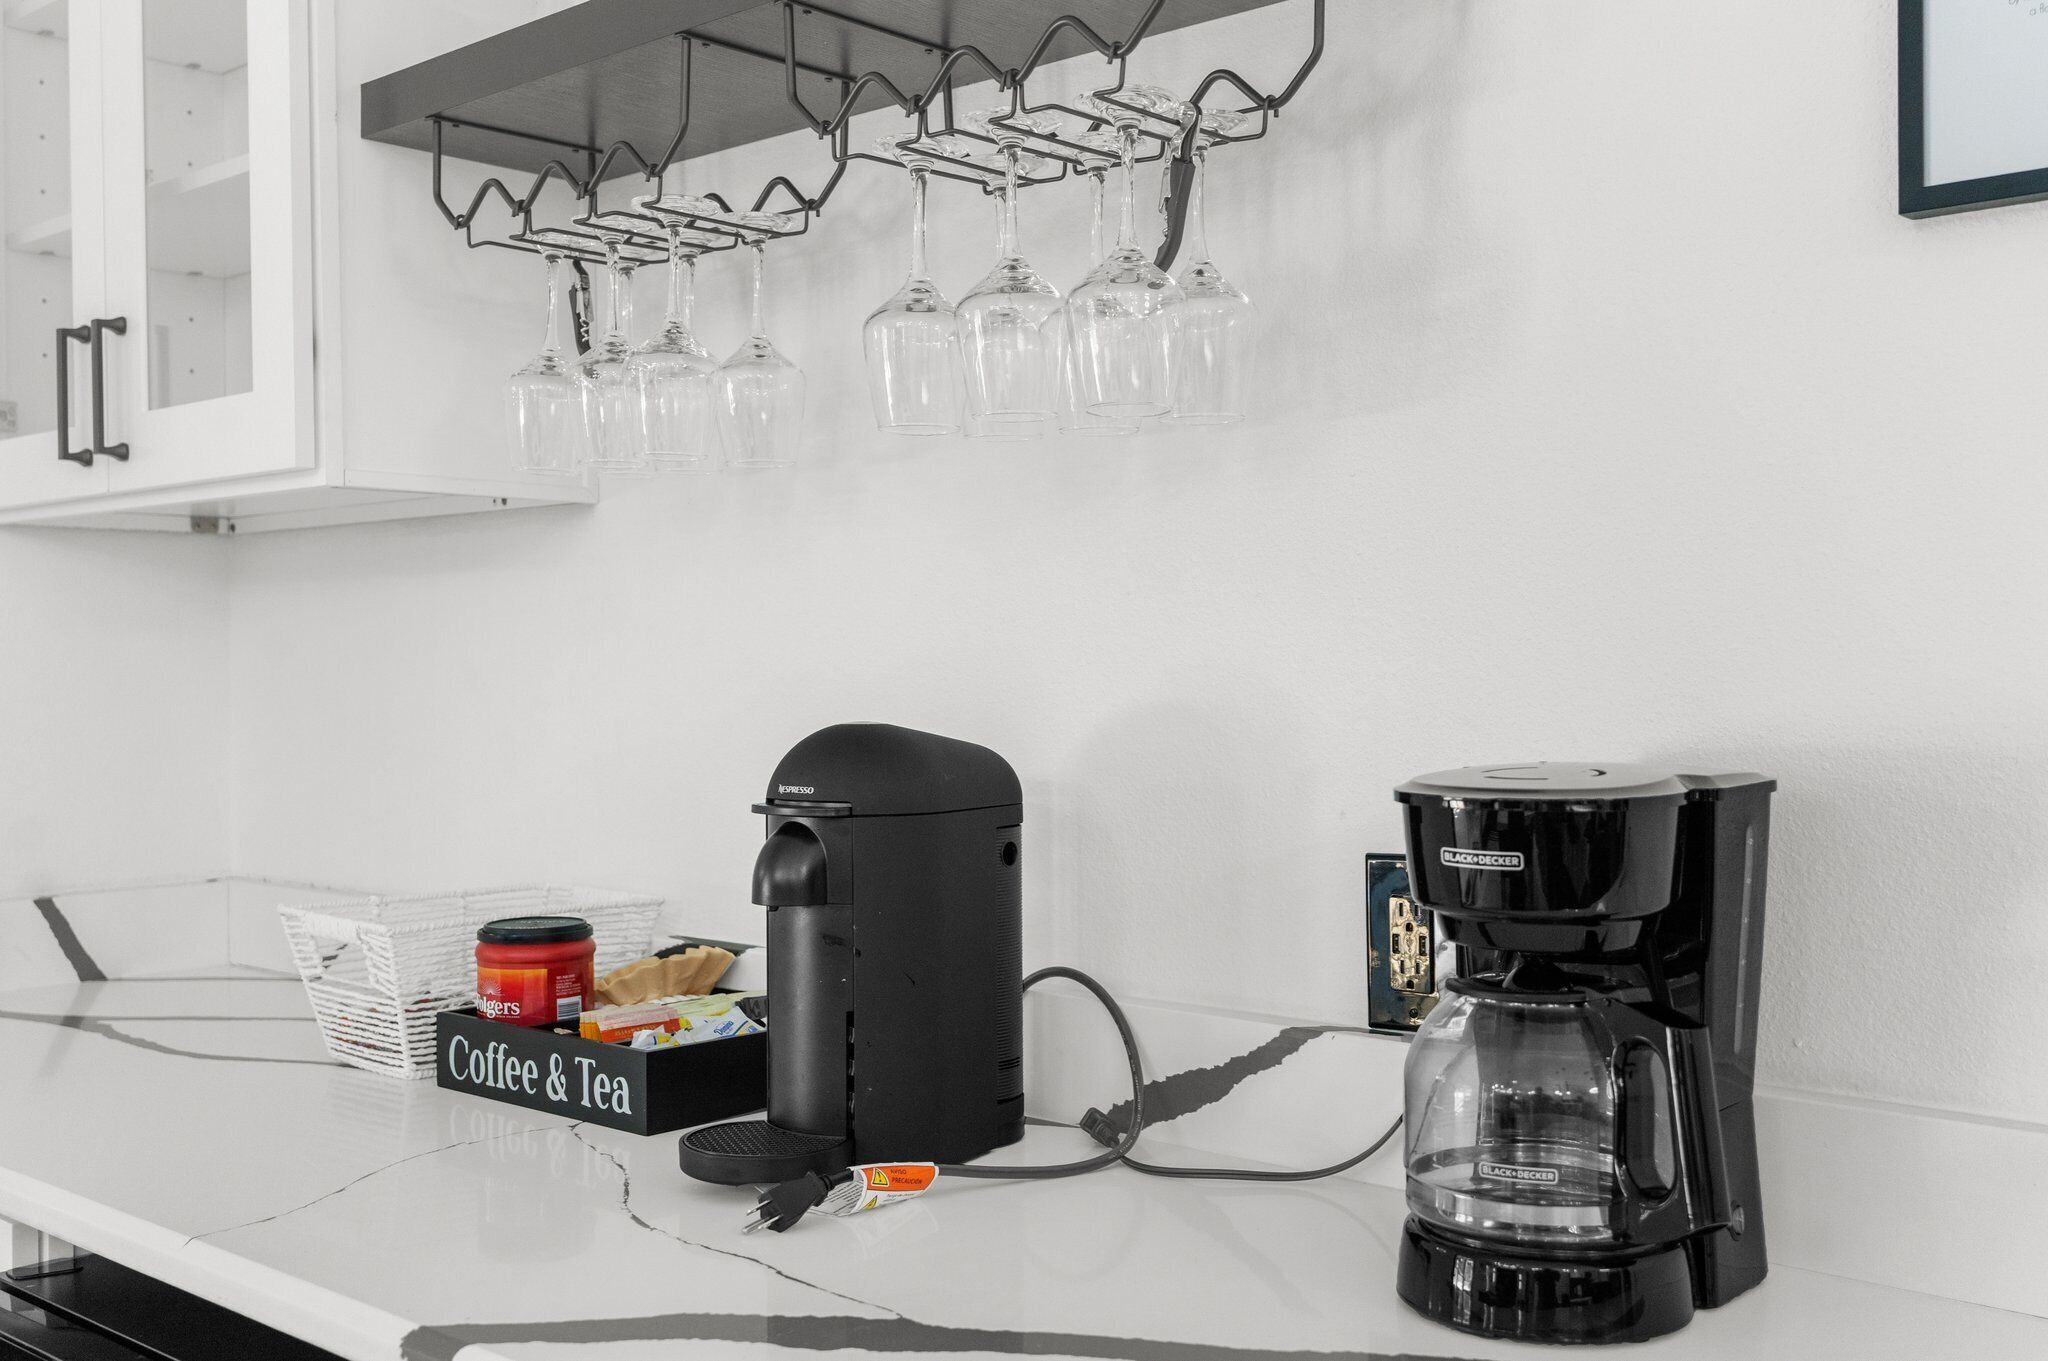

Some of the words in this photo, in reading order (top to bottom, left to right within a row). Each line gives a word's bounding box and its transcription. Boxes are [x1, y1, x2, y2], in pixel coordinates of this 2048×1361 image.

[778, 784, 814, 794] NESPRESSO
[1444, 852, 1519, 866] BLACK+DECKER
[449, 1034, 538, 1094] Coffee
[545, 1052, 568, 1102] &
[574, 1056, 632, 1115] Tea
[1482, 1165, 1555, 1181] BLACK+DECKER
